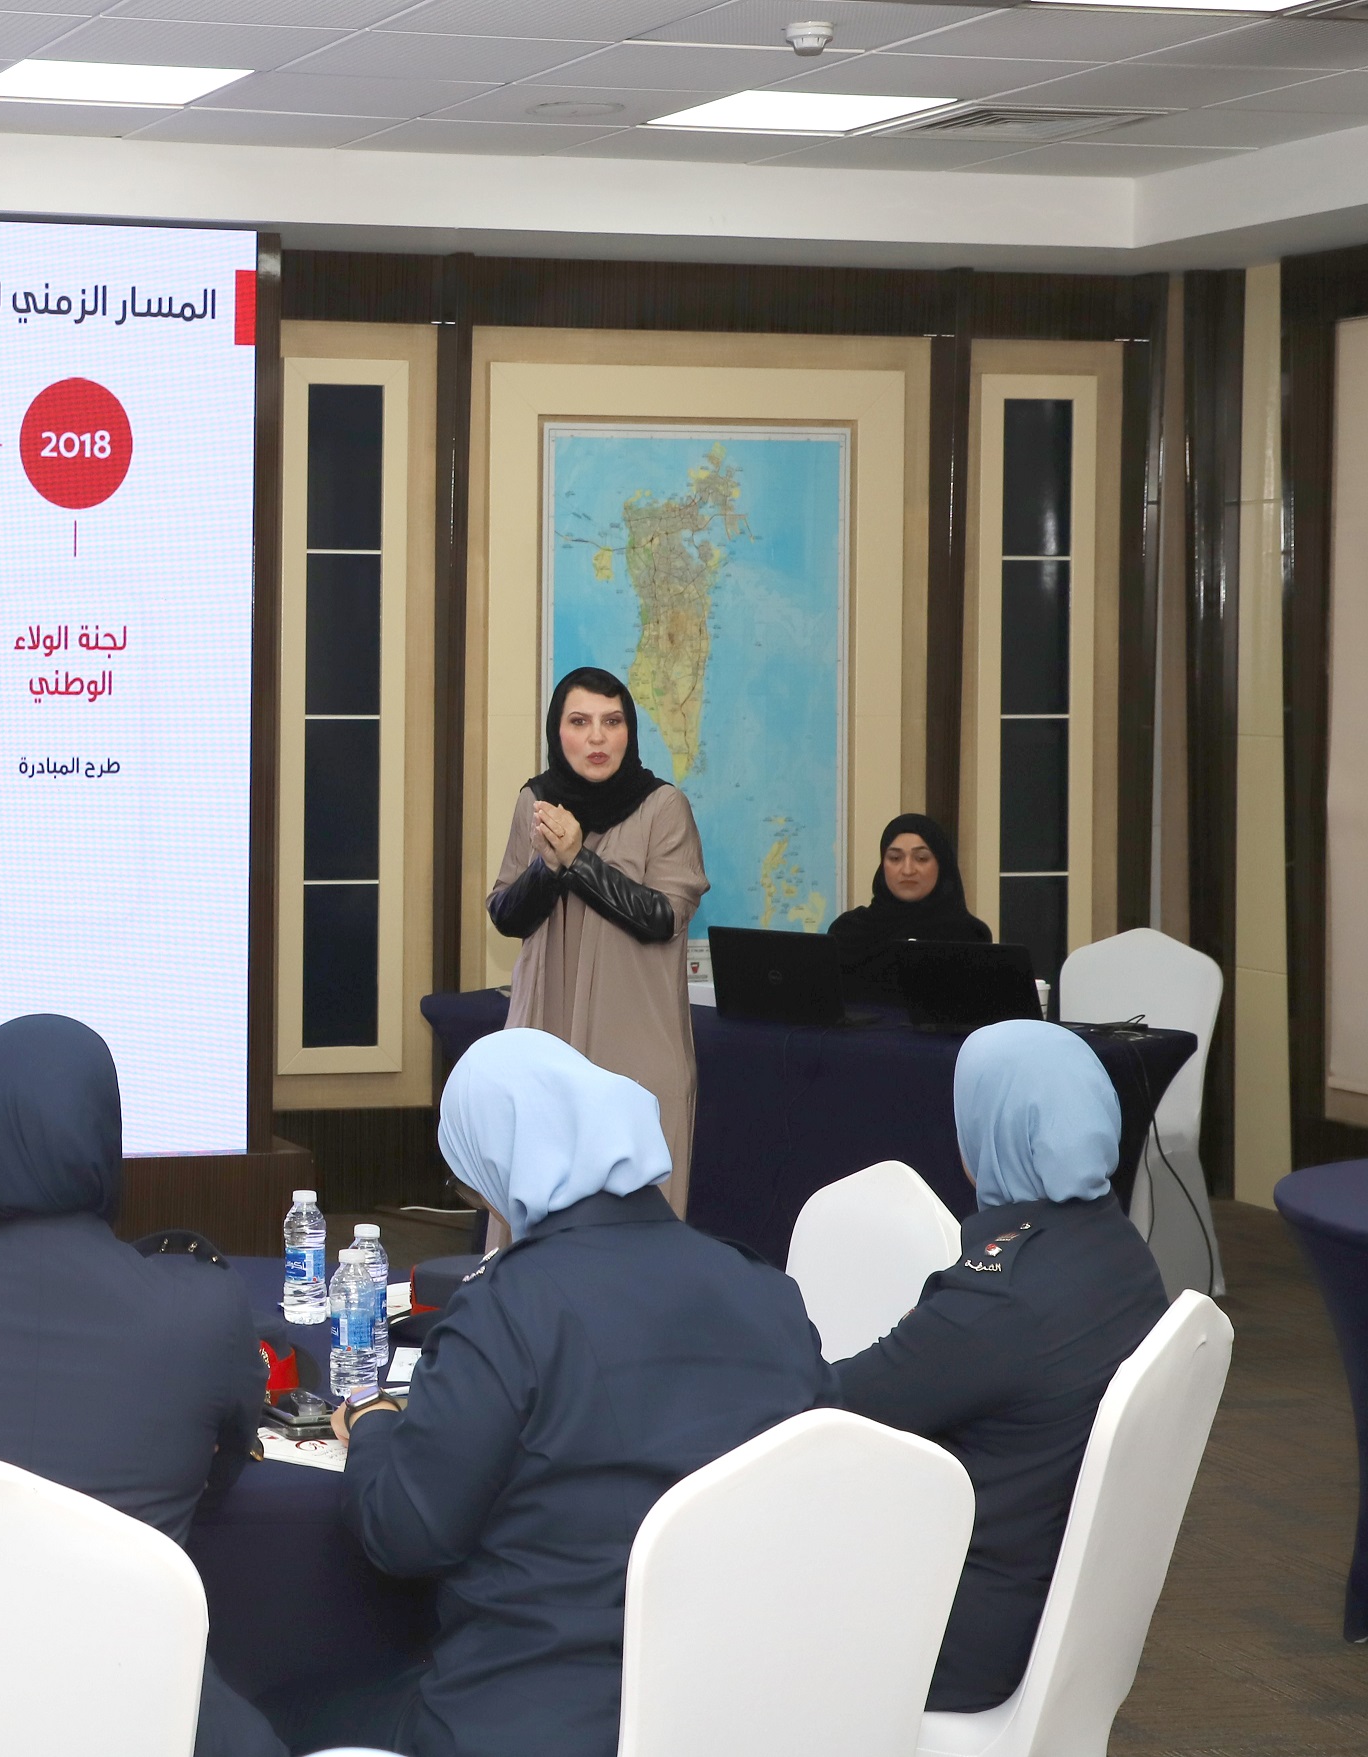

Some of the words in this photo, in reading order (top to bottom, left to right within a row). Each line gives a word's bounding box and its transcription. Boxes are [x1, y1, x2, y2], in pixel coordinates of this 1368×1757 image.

[12, 283, 107, 324] الزمني
[115, 286, 216, 325] المسار
[41, 431, 110, 458] 2018
[14, 625, 68, 657] الولاء
[78, 625, 127, 659] لجنة
[28, 670, 112, 704] الوطني
[19, 756, 79, 779] المبادرة
[85, 757, 120, 778] طرح
